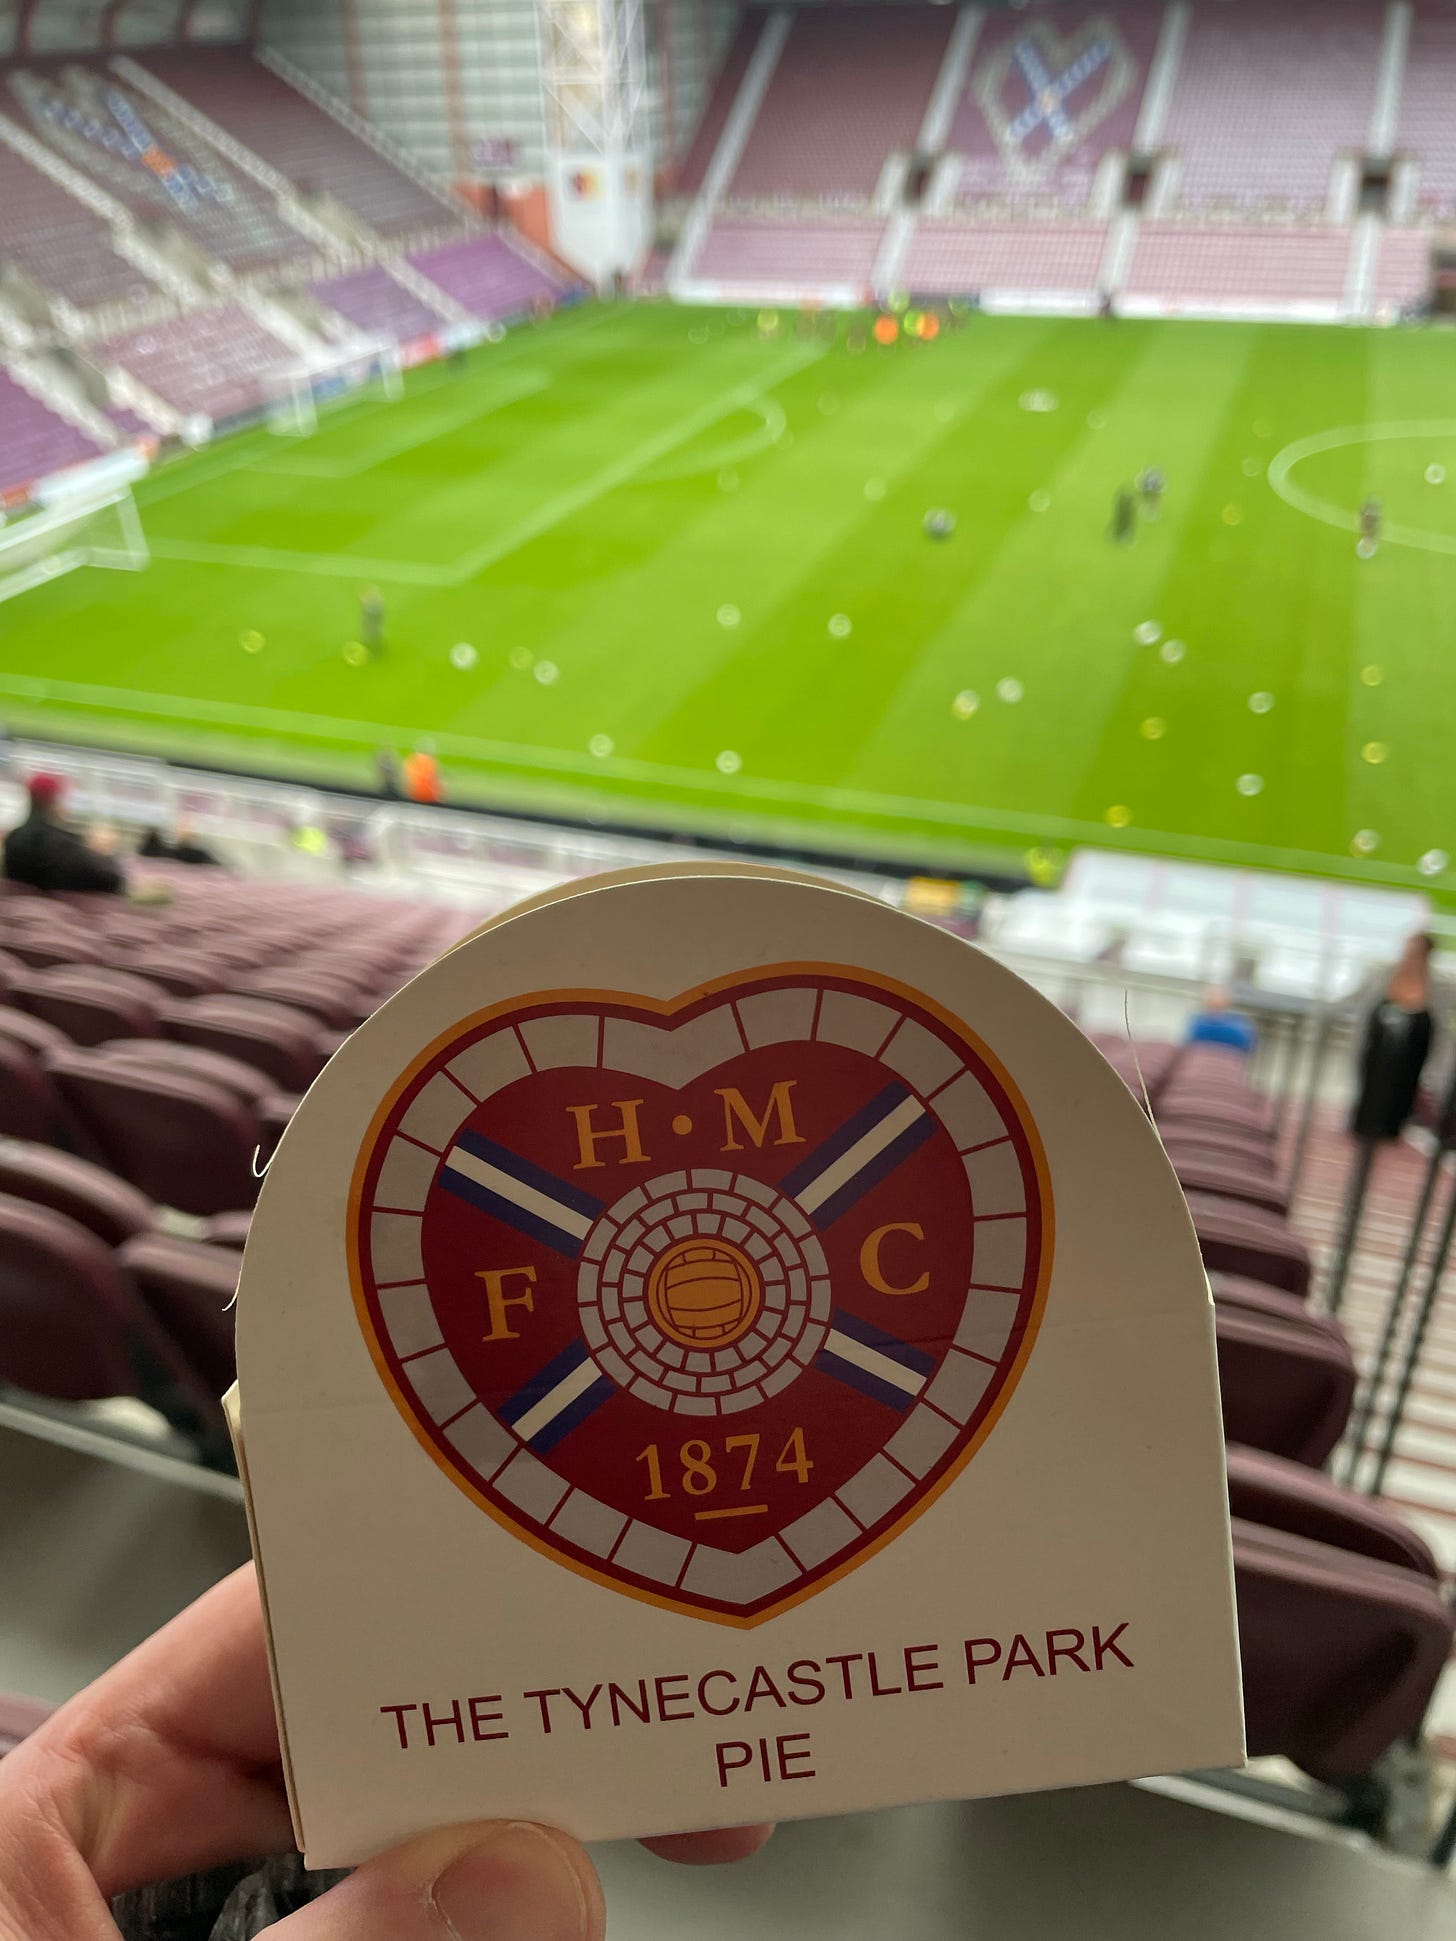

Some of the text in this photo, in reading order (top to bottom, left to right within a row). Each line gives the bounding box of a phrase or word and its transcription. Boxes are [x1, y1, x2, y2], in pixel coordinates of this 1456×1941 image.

[861, 1223, 930, 1294] C
[476, 1267, 537, 1340] F
[637, 1428, 813, 1499] 1874
[380, 1623, 1134, 1748] THE TYNECASTLE PARK
[716, 1733, 816, 1787] PIE
